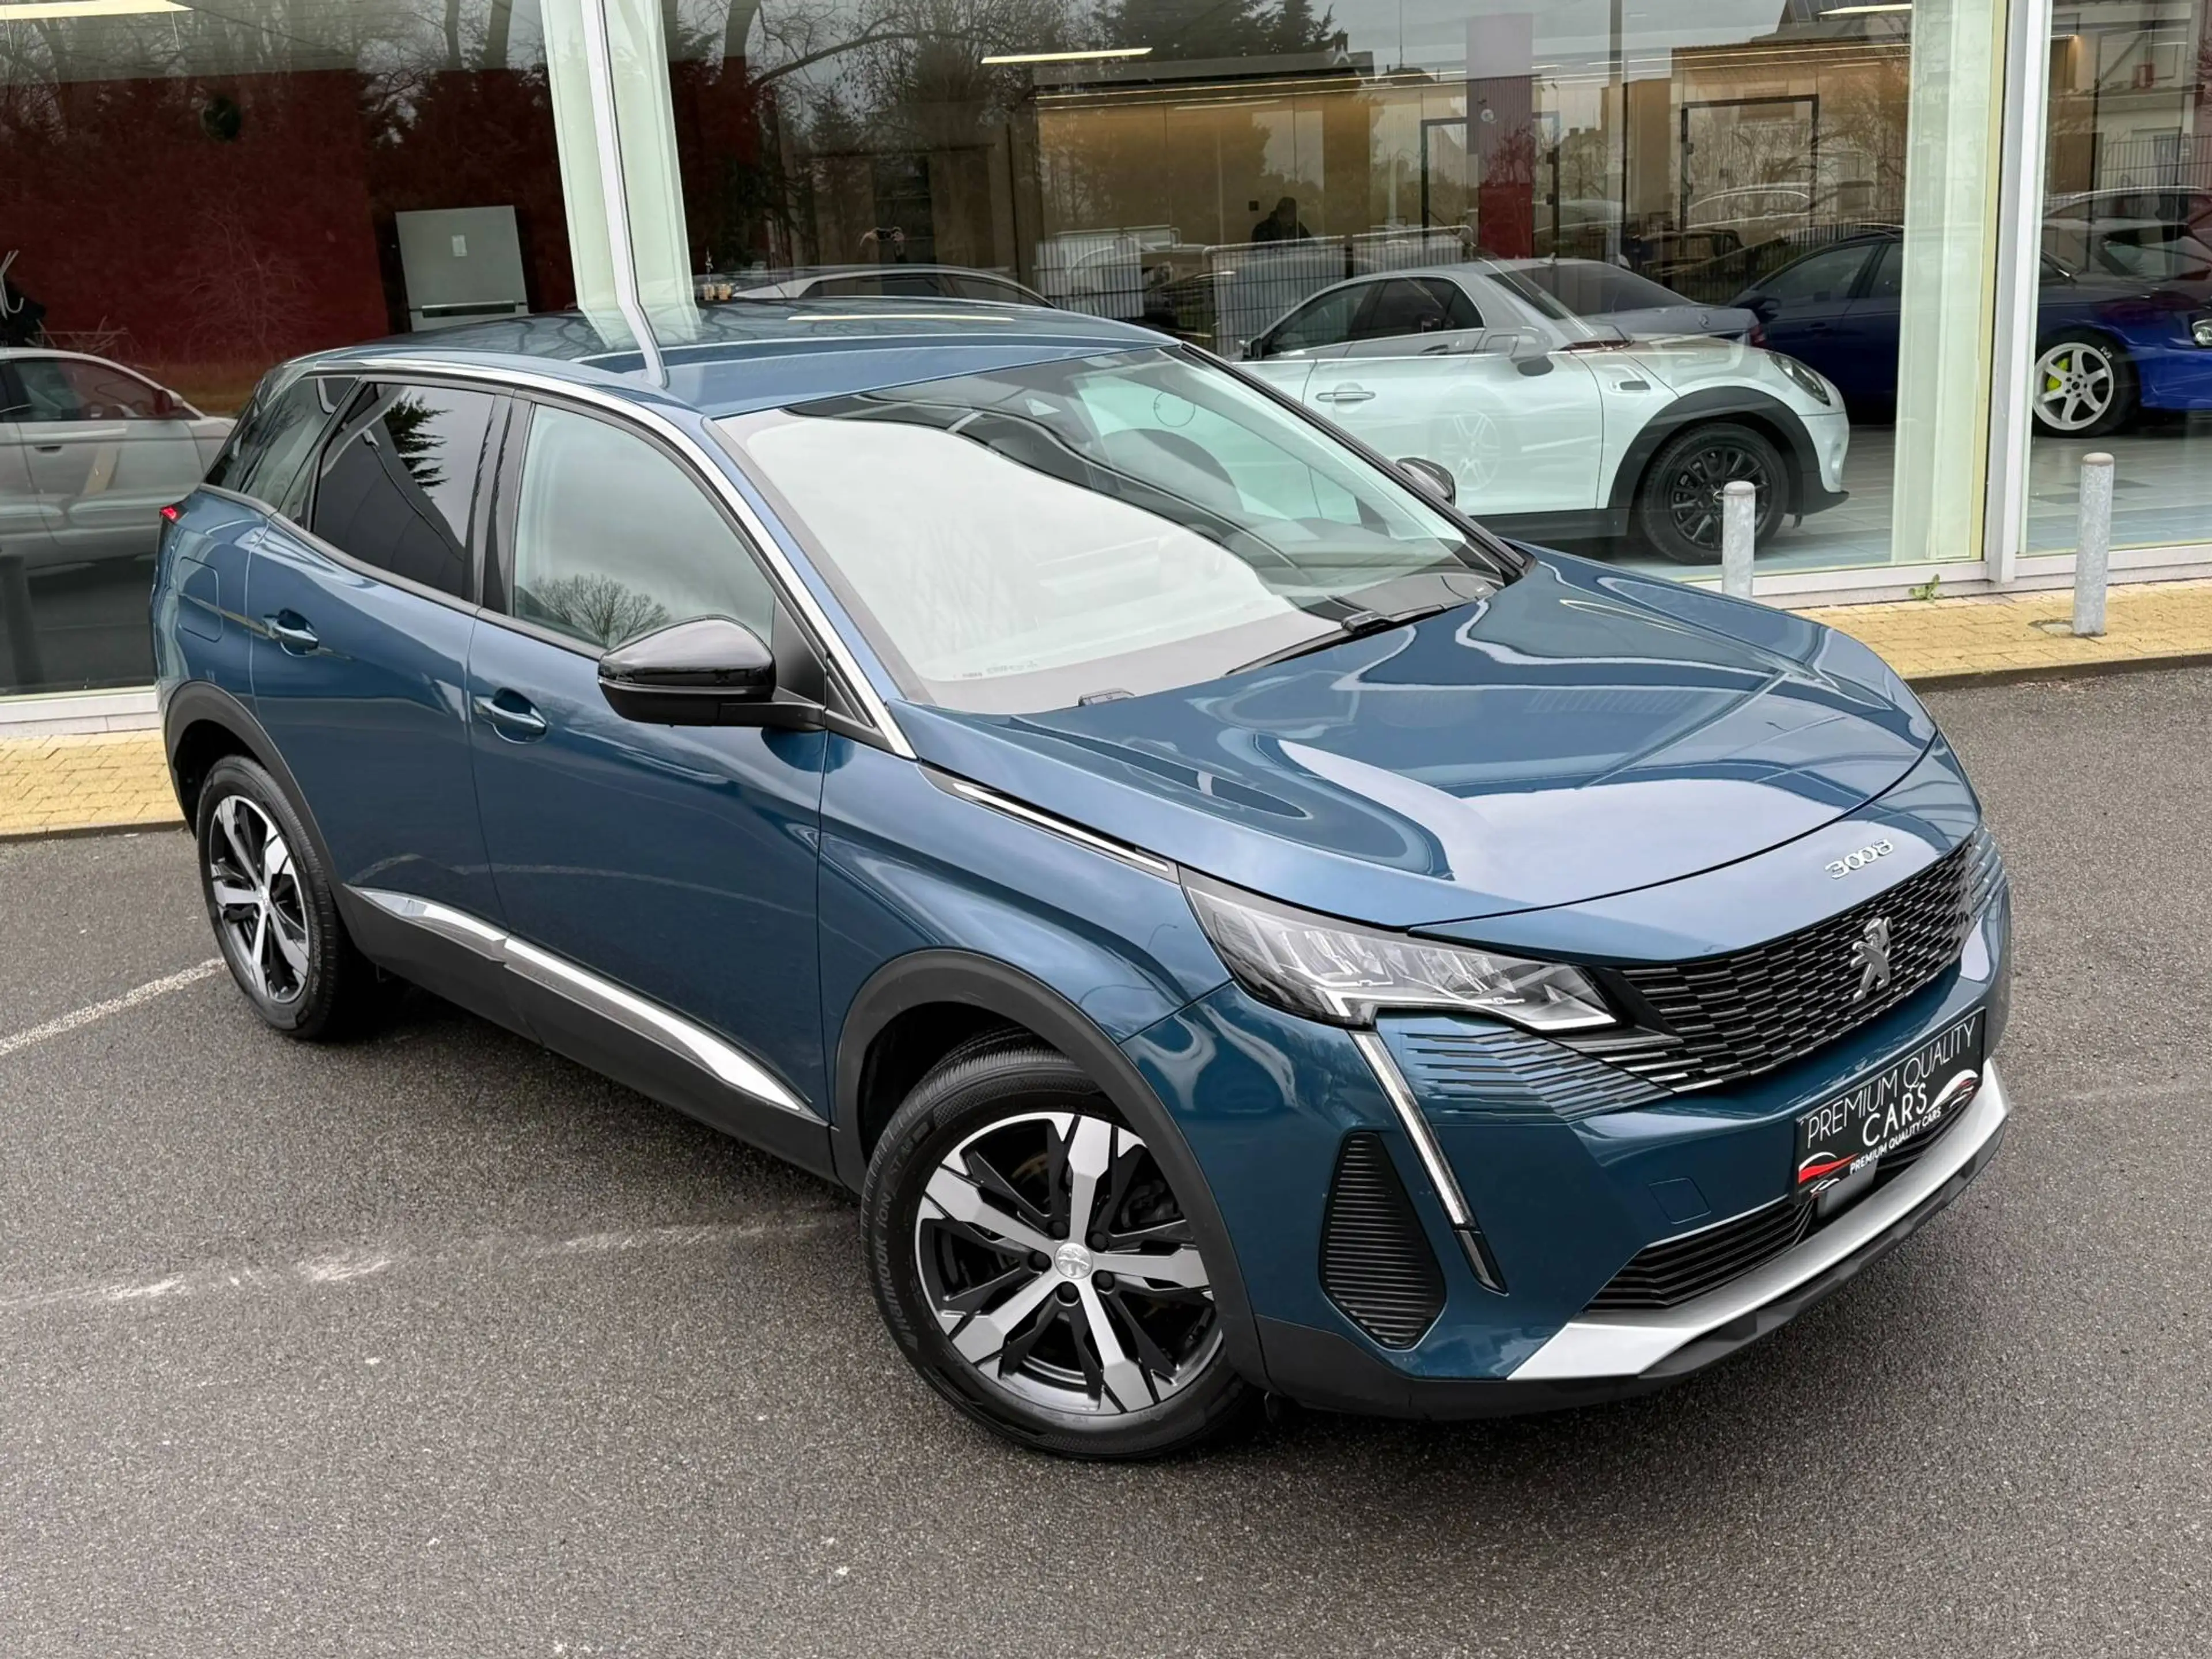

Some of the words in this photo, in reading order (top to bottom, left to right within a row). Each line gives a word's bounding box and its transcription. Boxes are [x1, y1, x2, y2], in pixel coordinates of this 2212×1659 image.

[1824, 839, 1893, 880] 3008
[1806, 1069, 1898, 1149] PREMIUM
[1903, 1017, 1976, 1089] QUALITY
[1862, 1082, 1928, 1147] CARS
[1849, 1143, 1889, 1175] PREMIUM
[1888, 1122, 1922, 1149] QUALITY
[1922, 1105, 1942, 1127] CARS
